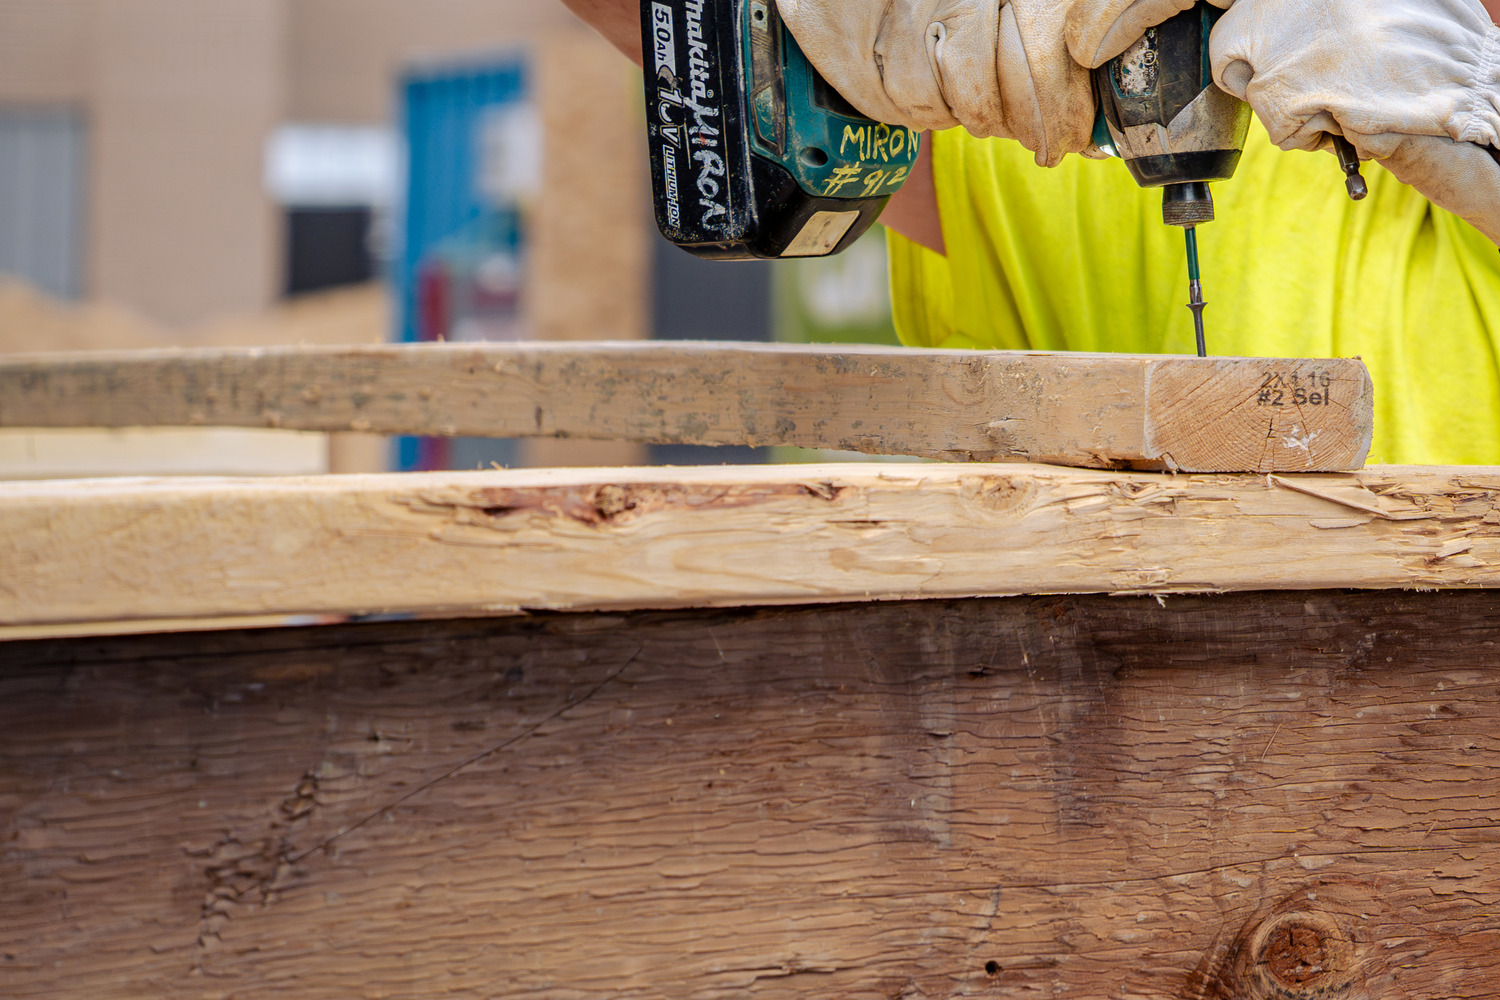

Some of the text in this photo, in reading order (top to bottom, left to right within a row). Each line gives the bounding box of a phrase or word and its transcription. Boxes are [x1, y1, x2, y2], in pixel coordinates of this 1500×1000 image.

[655, 8, 671, 61] 5.0Ah
[683, 97, 725, 231] MIRON
[840, 122, 919, 162] MIRON
[1258, 387, 1329, 406] #2 Sel
